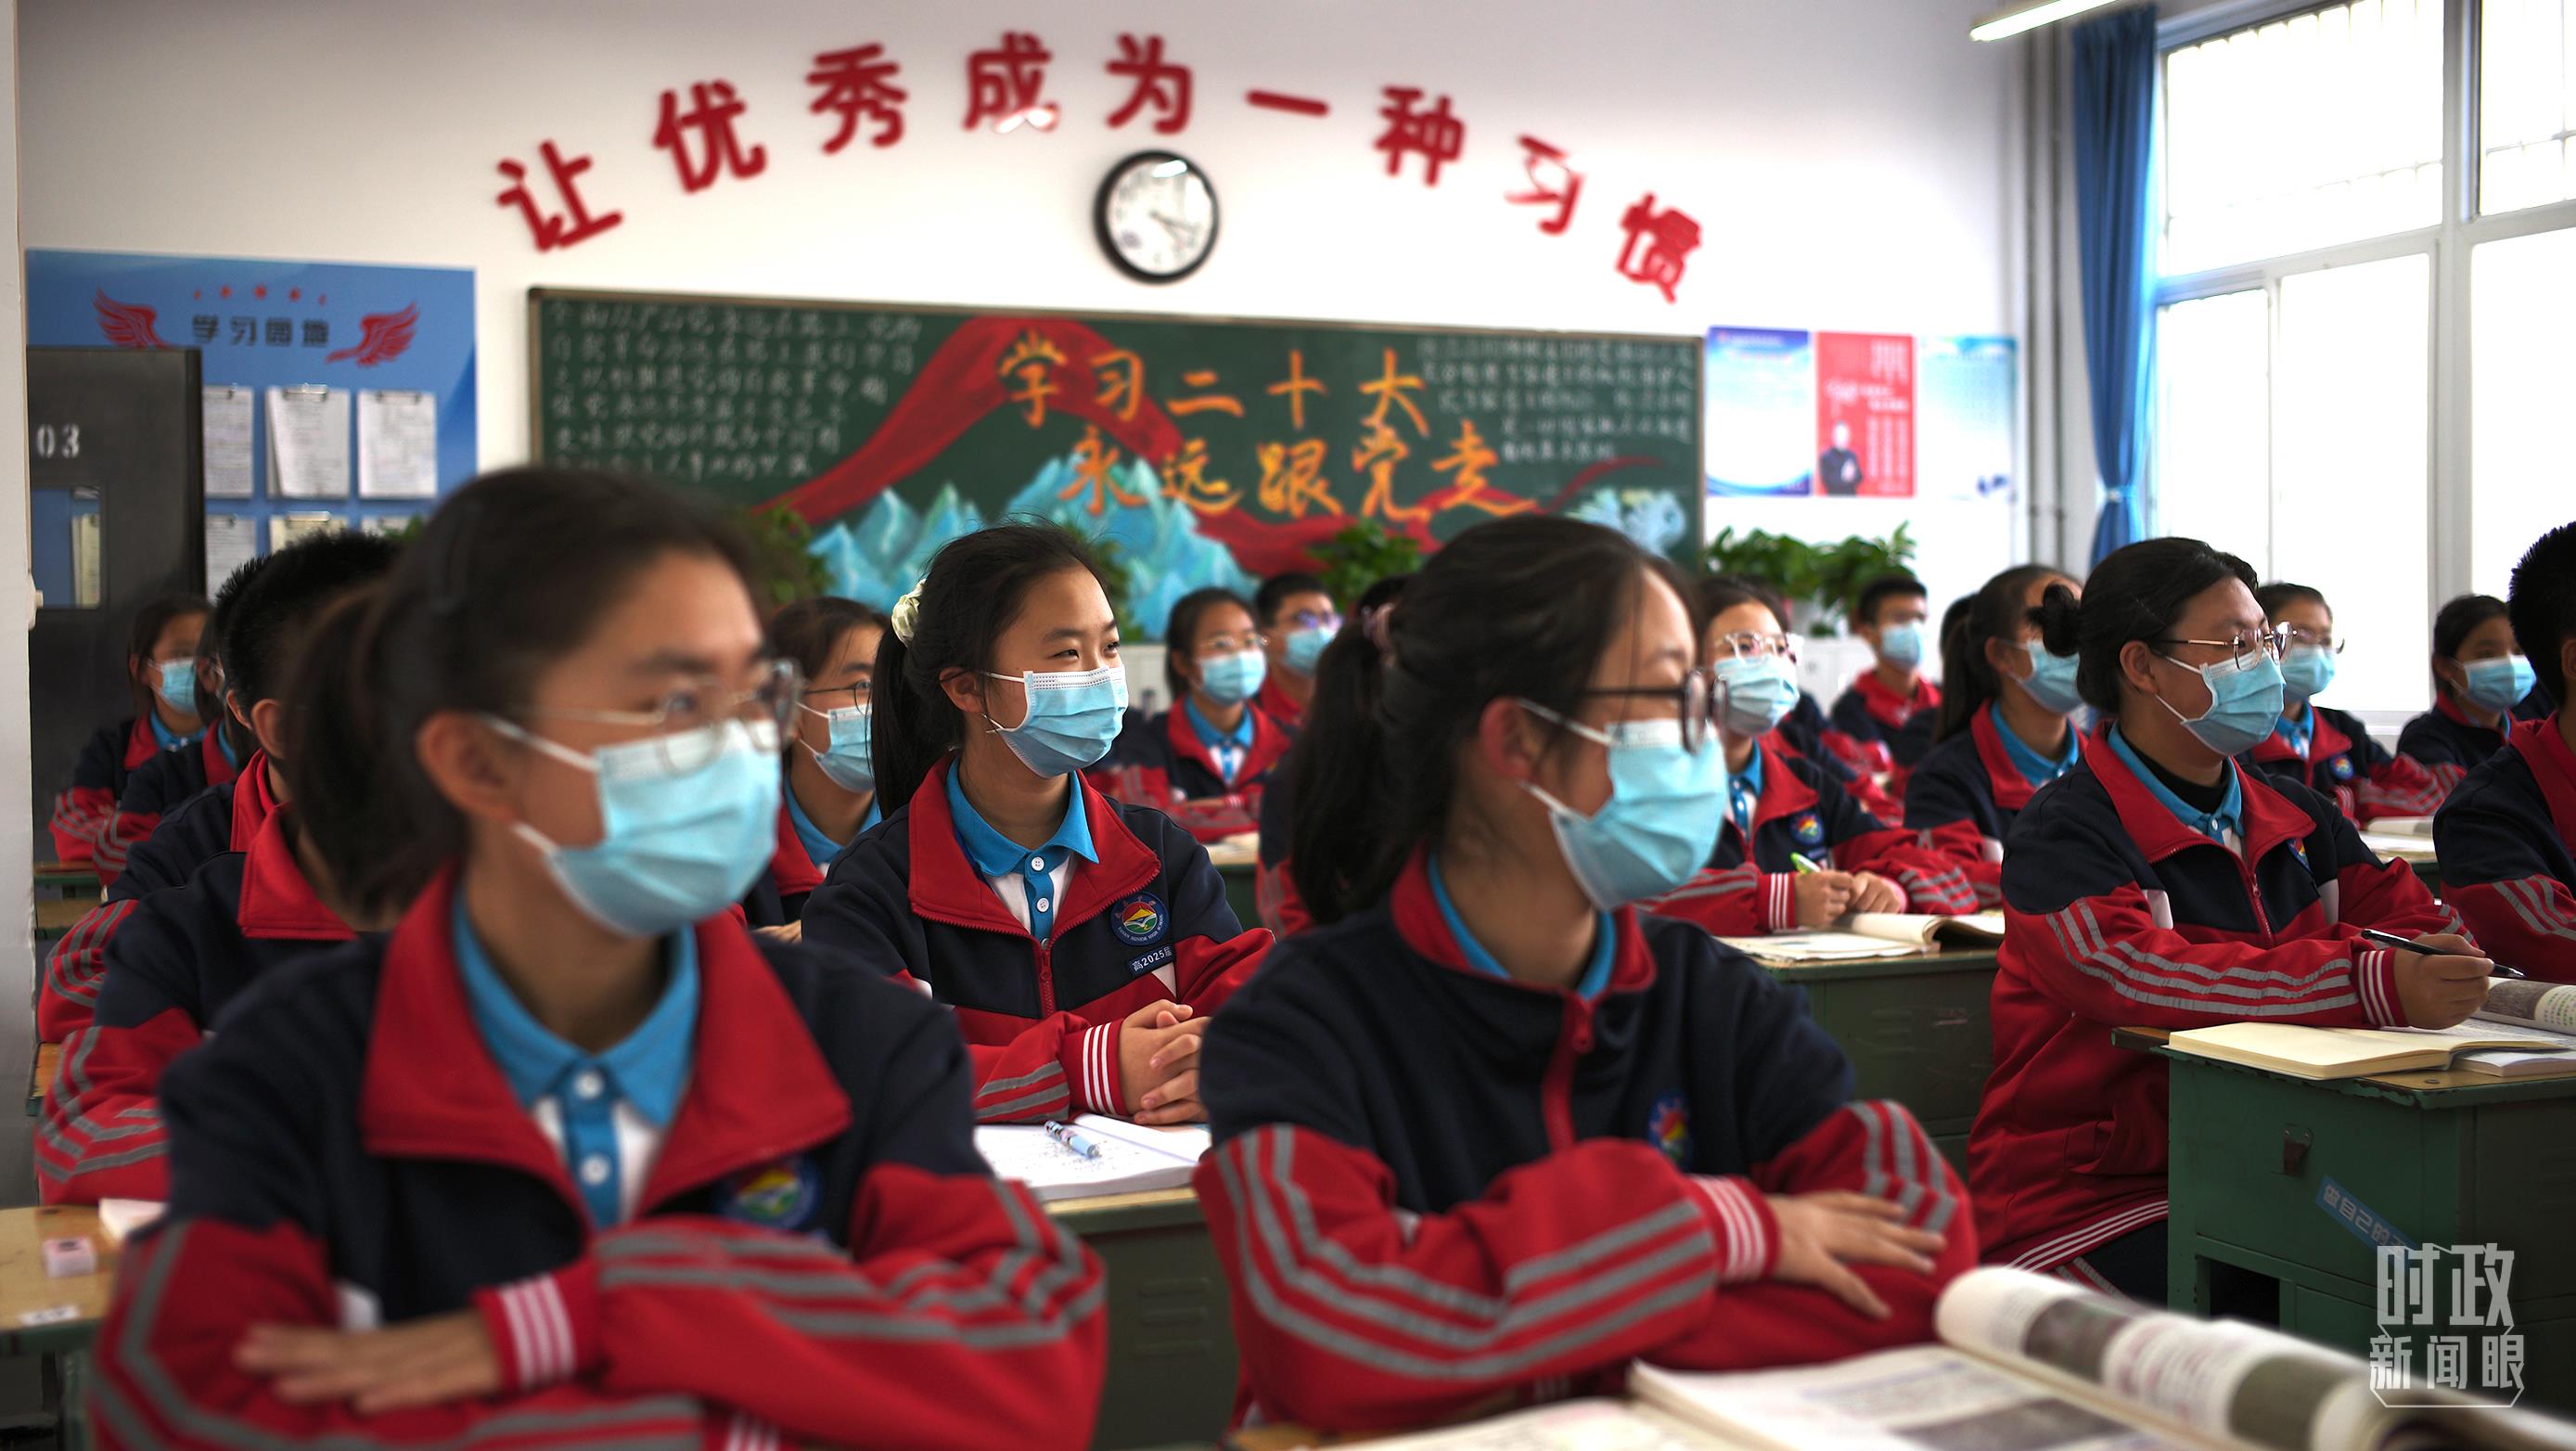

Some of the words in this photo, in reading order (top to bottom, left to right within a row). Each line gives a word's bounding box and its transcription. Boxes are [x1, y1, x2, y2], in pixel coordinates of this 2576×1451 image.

[496, 31, 1704, 302] 让优秀成为一种习惯
[1000, 331, 1430, 438] 学习二十大
[1057, 417, 1538, 521] 永远跟党走
